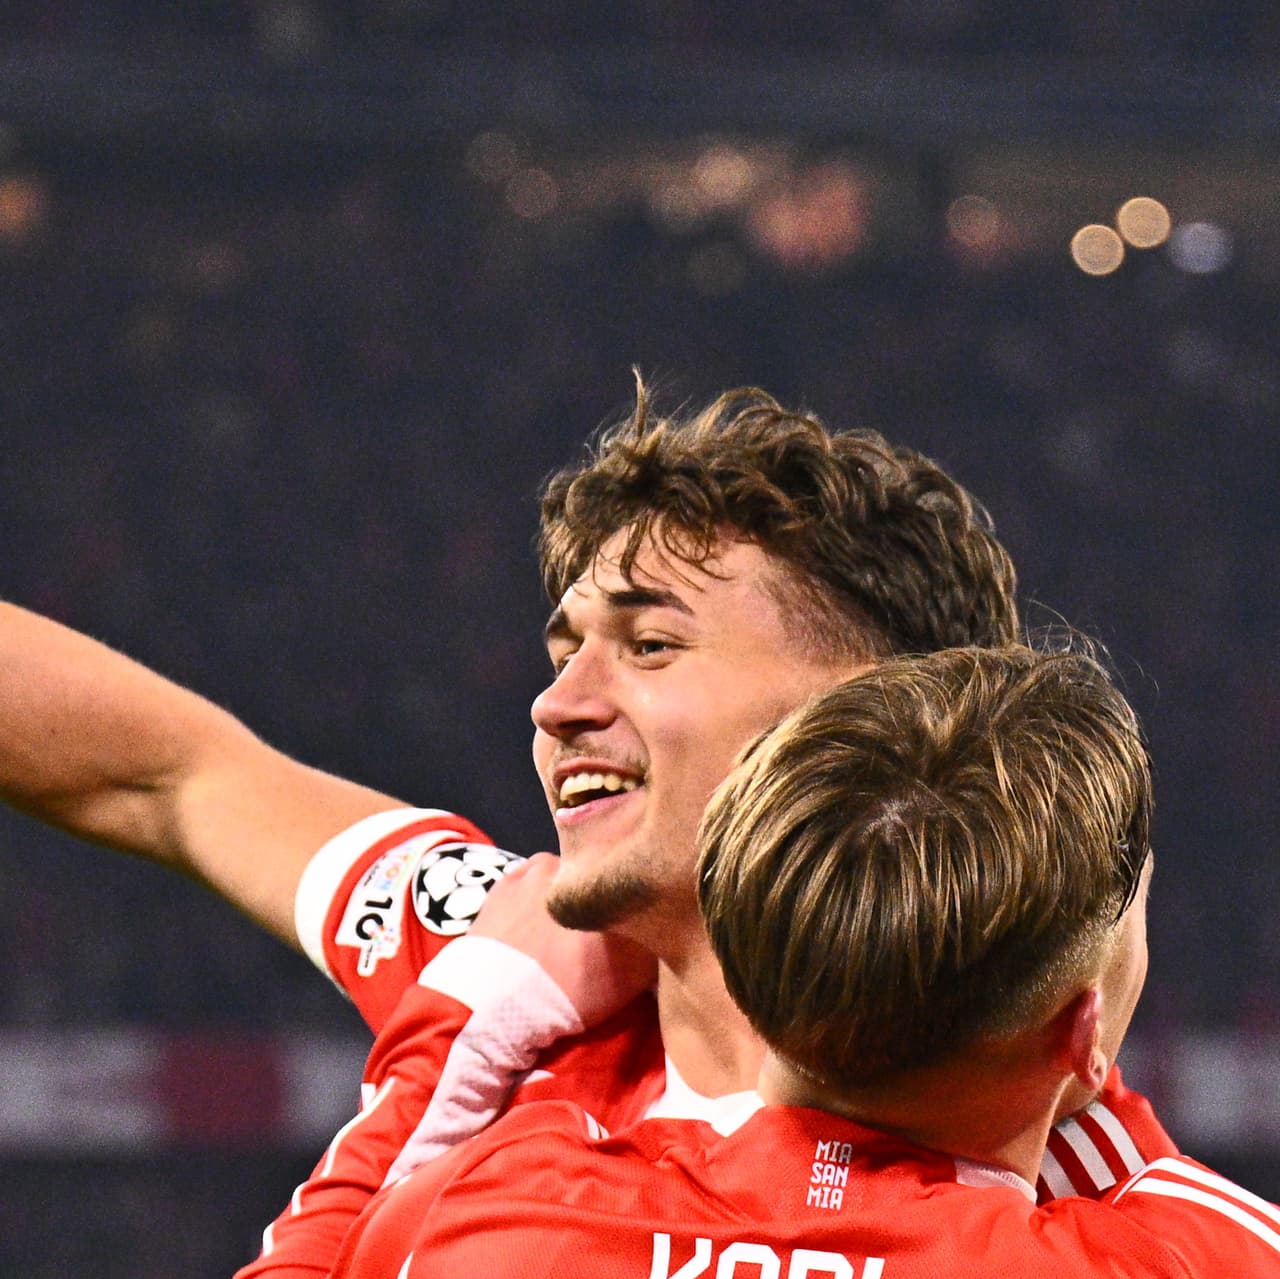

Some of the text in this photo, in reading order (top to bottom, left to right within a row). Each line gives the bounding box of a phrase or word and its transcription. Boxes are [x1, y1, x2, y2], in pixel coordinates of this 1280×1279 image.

[815, 1139, 853, 1165] MIA
[810, 1161, 849, 1188] SAN
[806, 1184, 844, 1211] MIA
